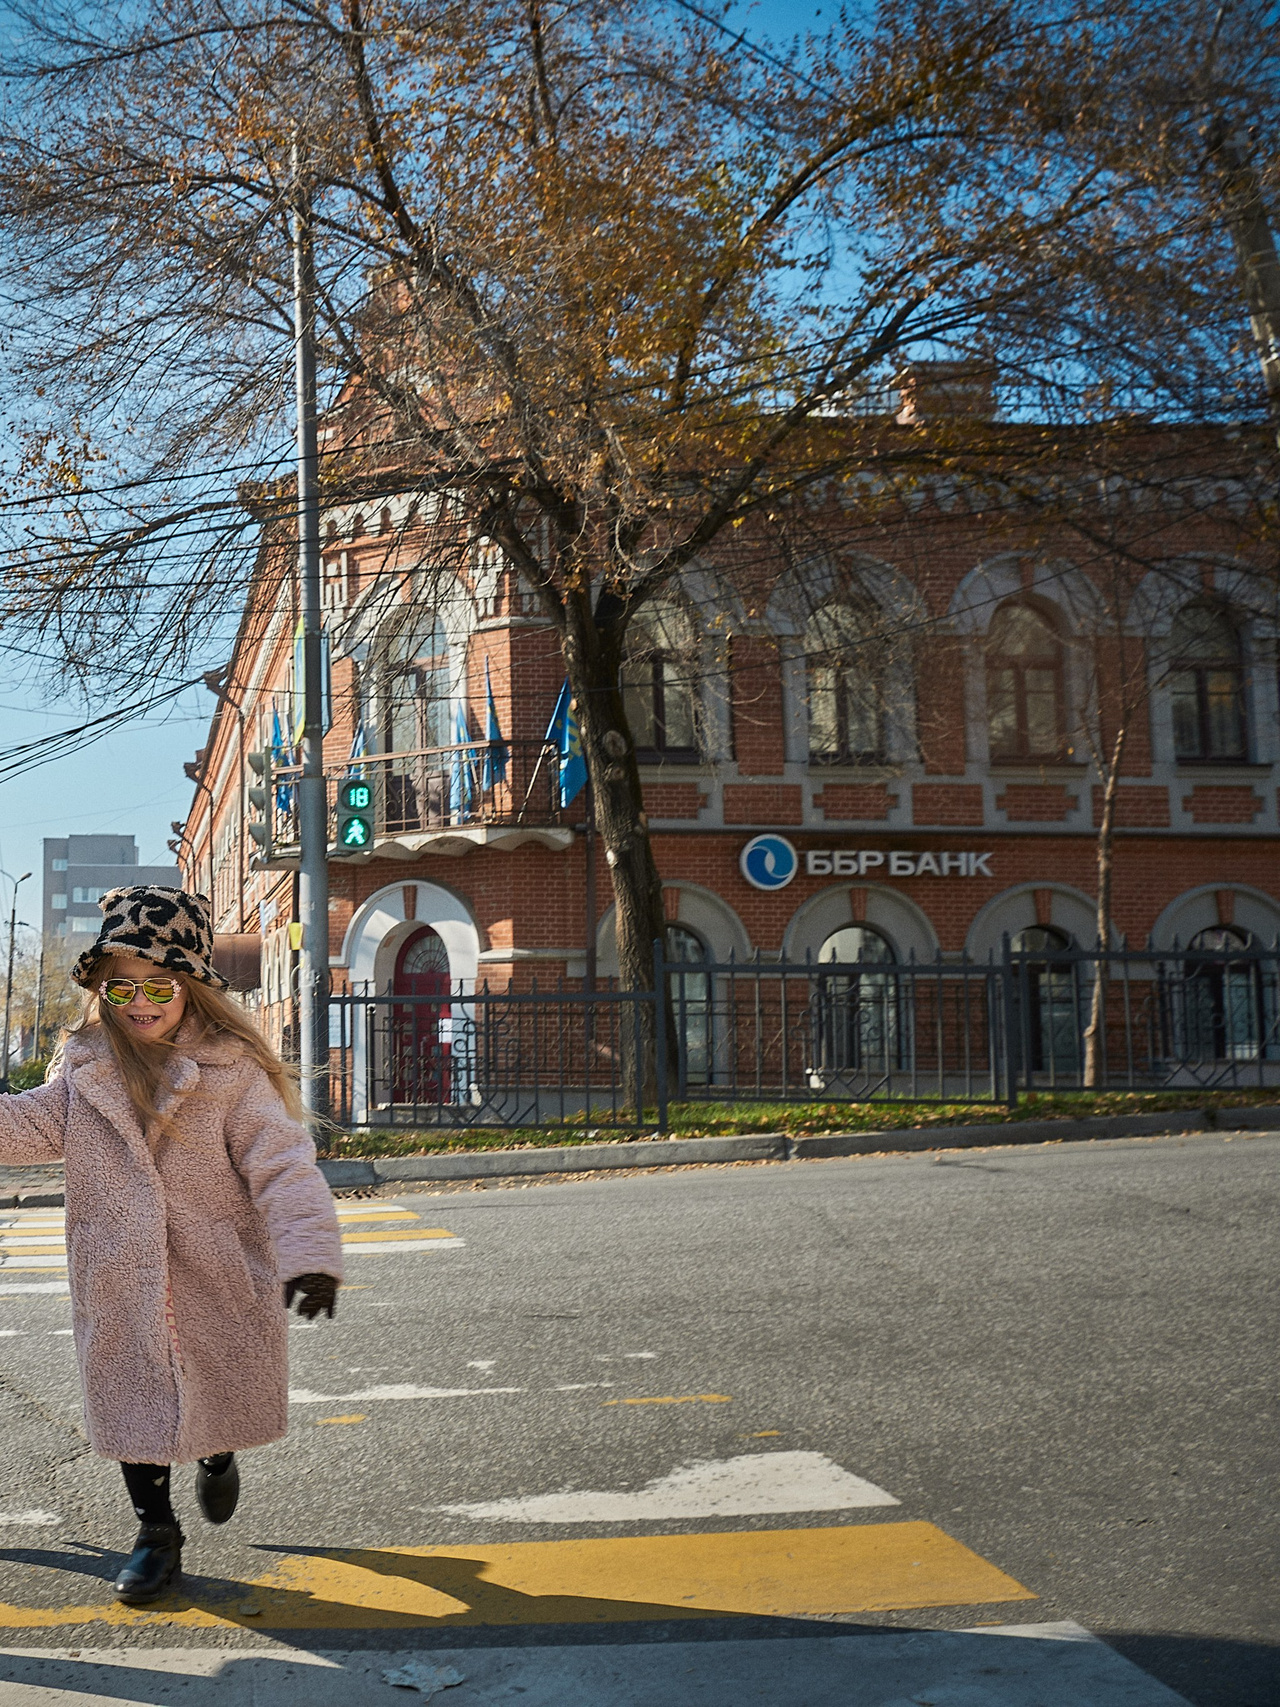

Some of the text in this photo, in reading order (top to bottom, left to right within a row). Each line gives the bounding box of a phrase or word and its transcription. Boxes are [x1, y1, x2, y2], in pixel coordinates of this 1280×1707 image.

[349, 787, 369, 807] 18
[807, 850, 994, 877] ББР БАНК
